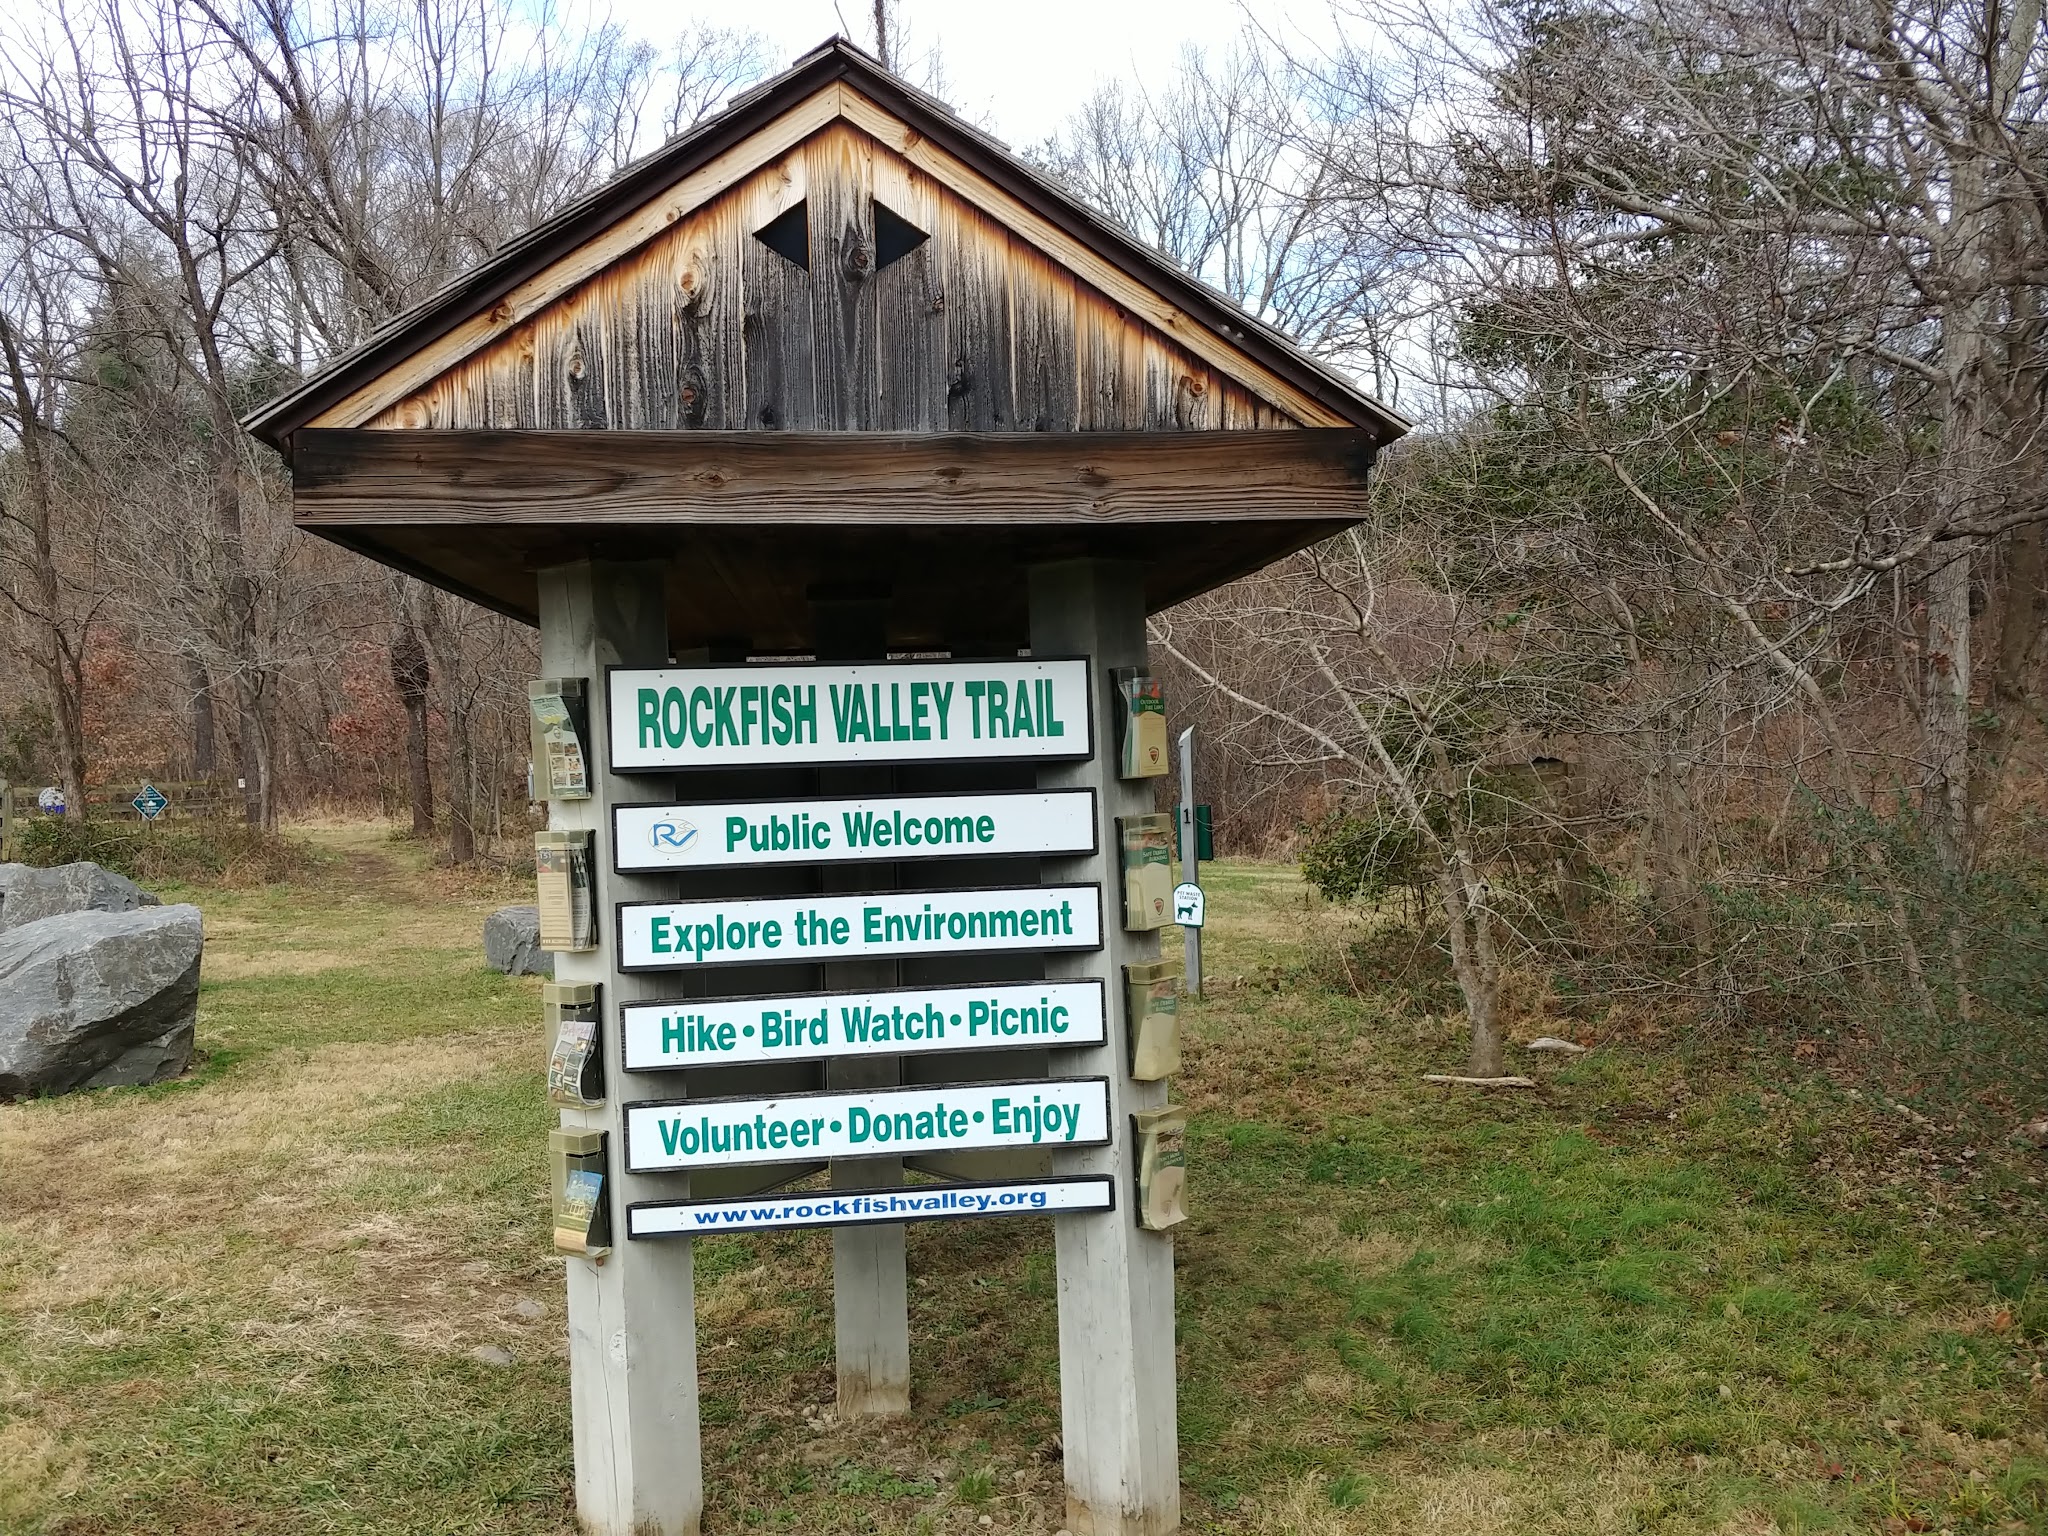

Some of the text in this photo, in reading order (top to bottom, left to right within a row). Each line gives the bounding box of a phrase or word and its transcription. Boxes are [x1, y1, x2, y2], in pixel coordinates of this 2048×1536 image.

[637, 678, 1065, 749] ROCKFISH VALLEY TRAIL
[726, 809, 996, 853] Public Welcome
[1183, 808, 1191, 825] 1
[651, 900, 1073, 962] Explore the Environment
[661, 998, 1069, 1054] Hike Bird Watch Picnic
[657, 1095, 1081, 1156] Volunteer Donate Enjoy
[693, 1189, 1047, 1225] www.rockfishvalley.org
